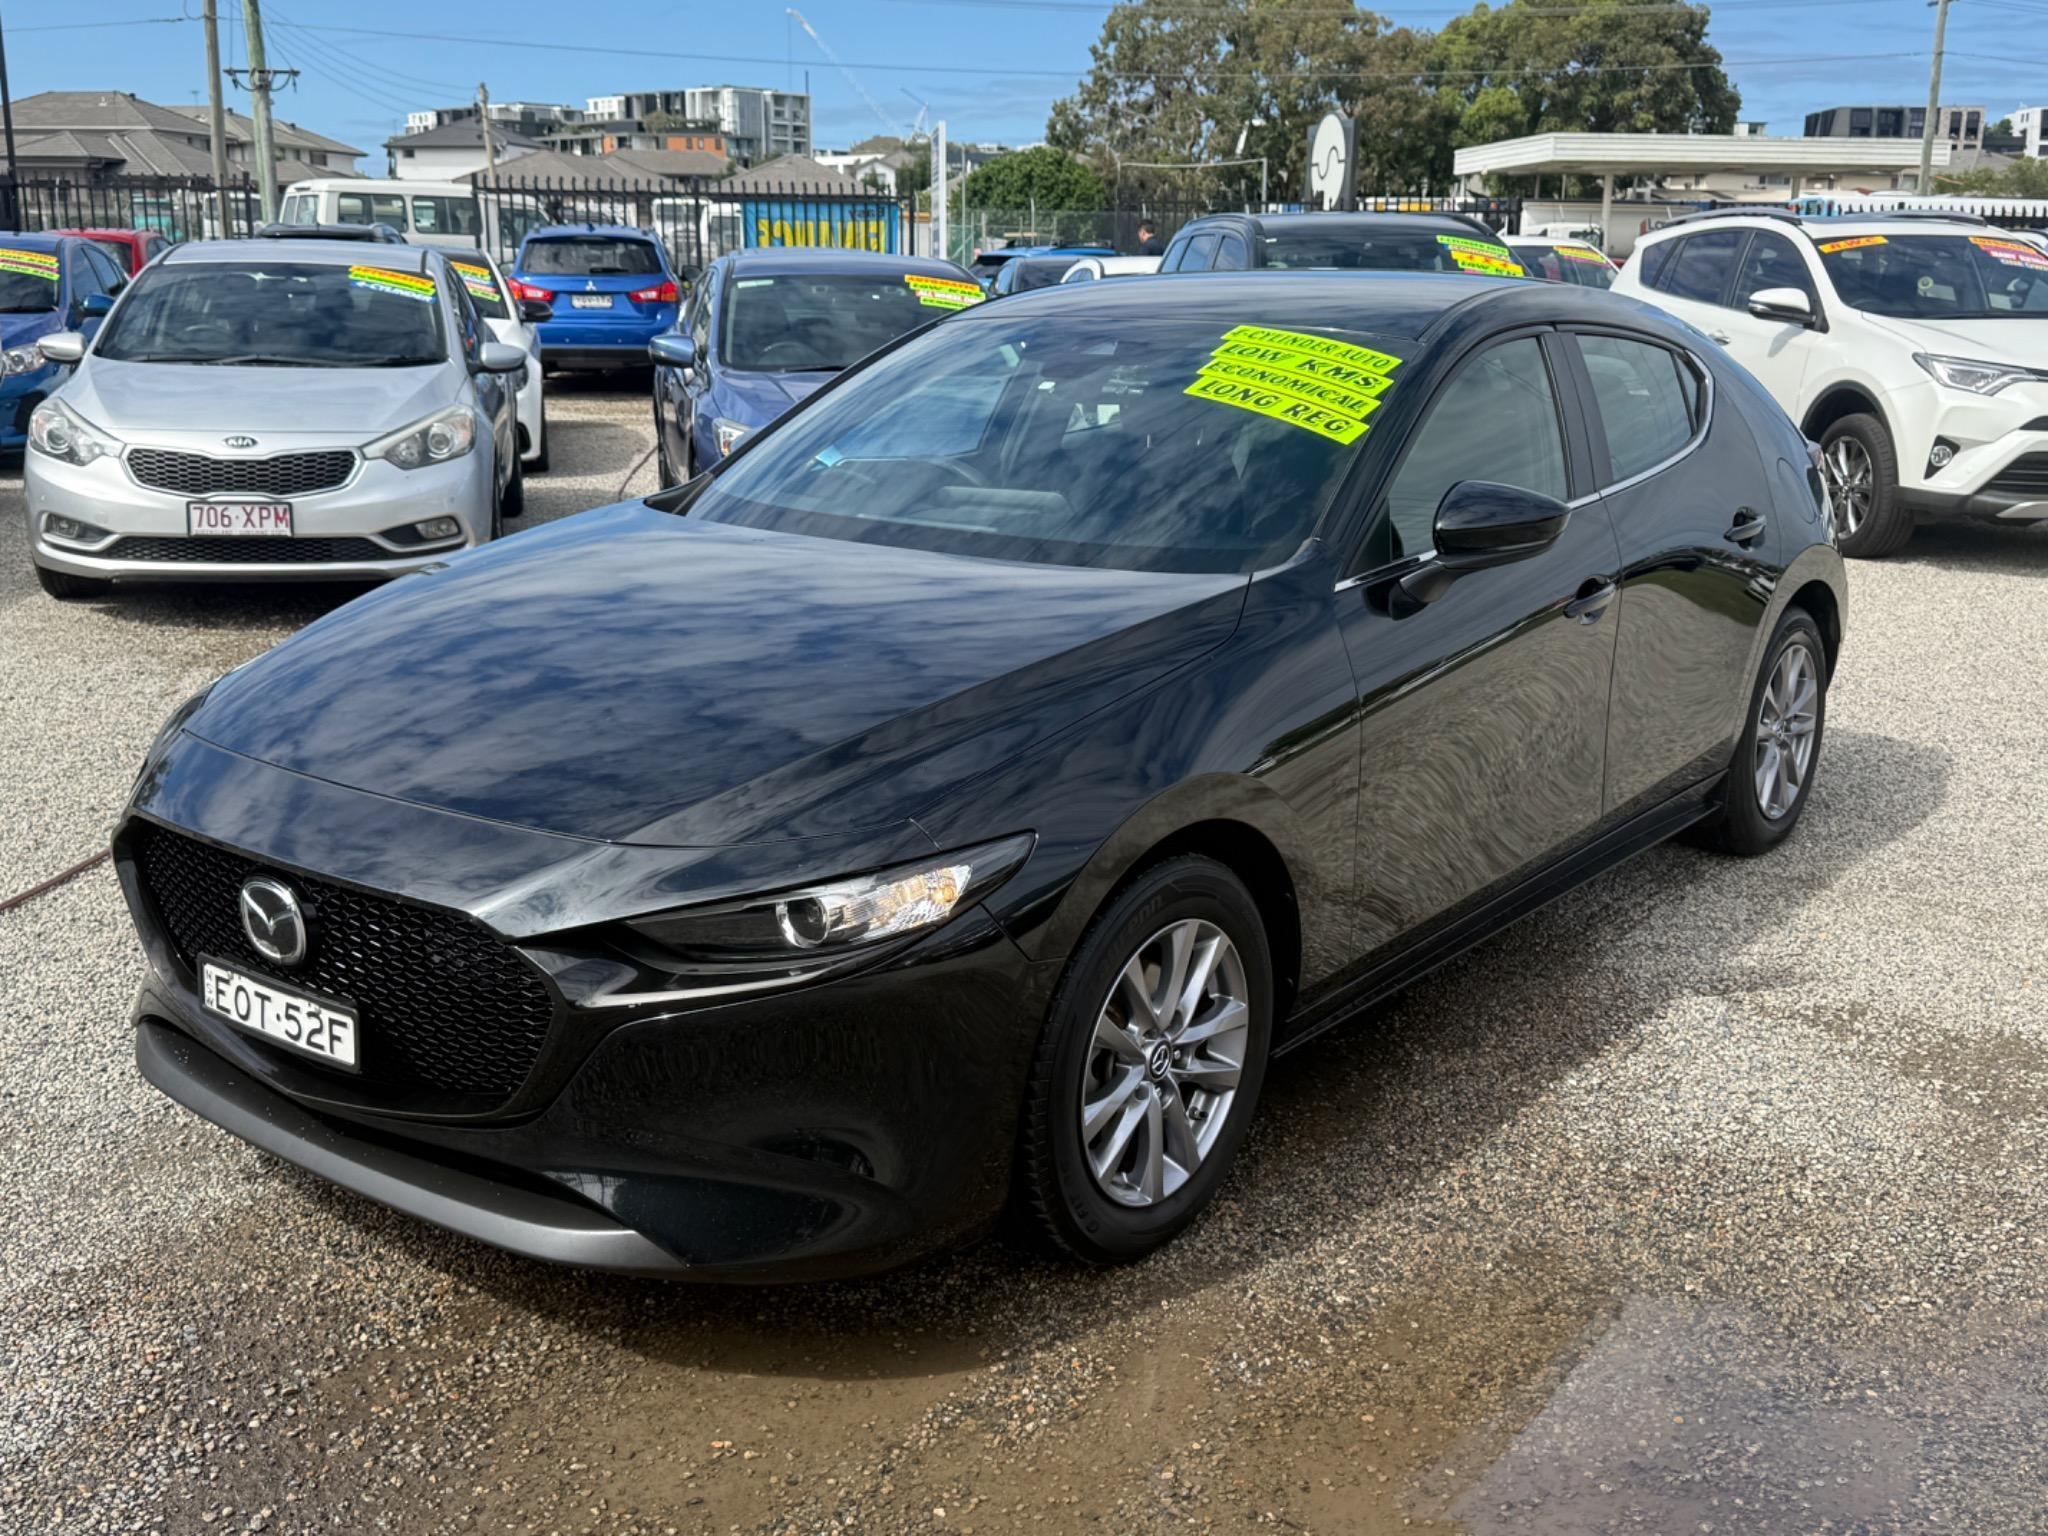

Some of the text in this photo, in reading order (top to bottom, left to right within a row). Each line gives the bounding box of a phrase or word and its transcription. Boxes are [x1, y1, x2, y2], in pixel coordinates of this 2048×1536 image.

[1221, 343, 1383, 389] LOW KMS
[1336, 345, 1391, 369] AUTO
[1199, 379, 1354, 434] LONG REG
[1207, 361, 1369, 412] ECONOMICAL
[227, 437, 254, 447] KIA
